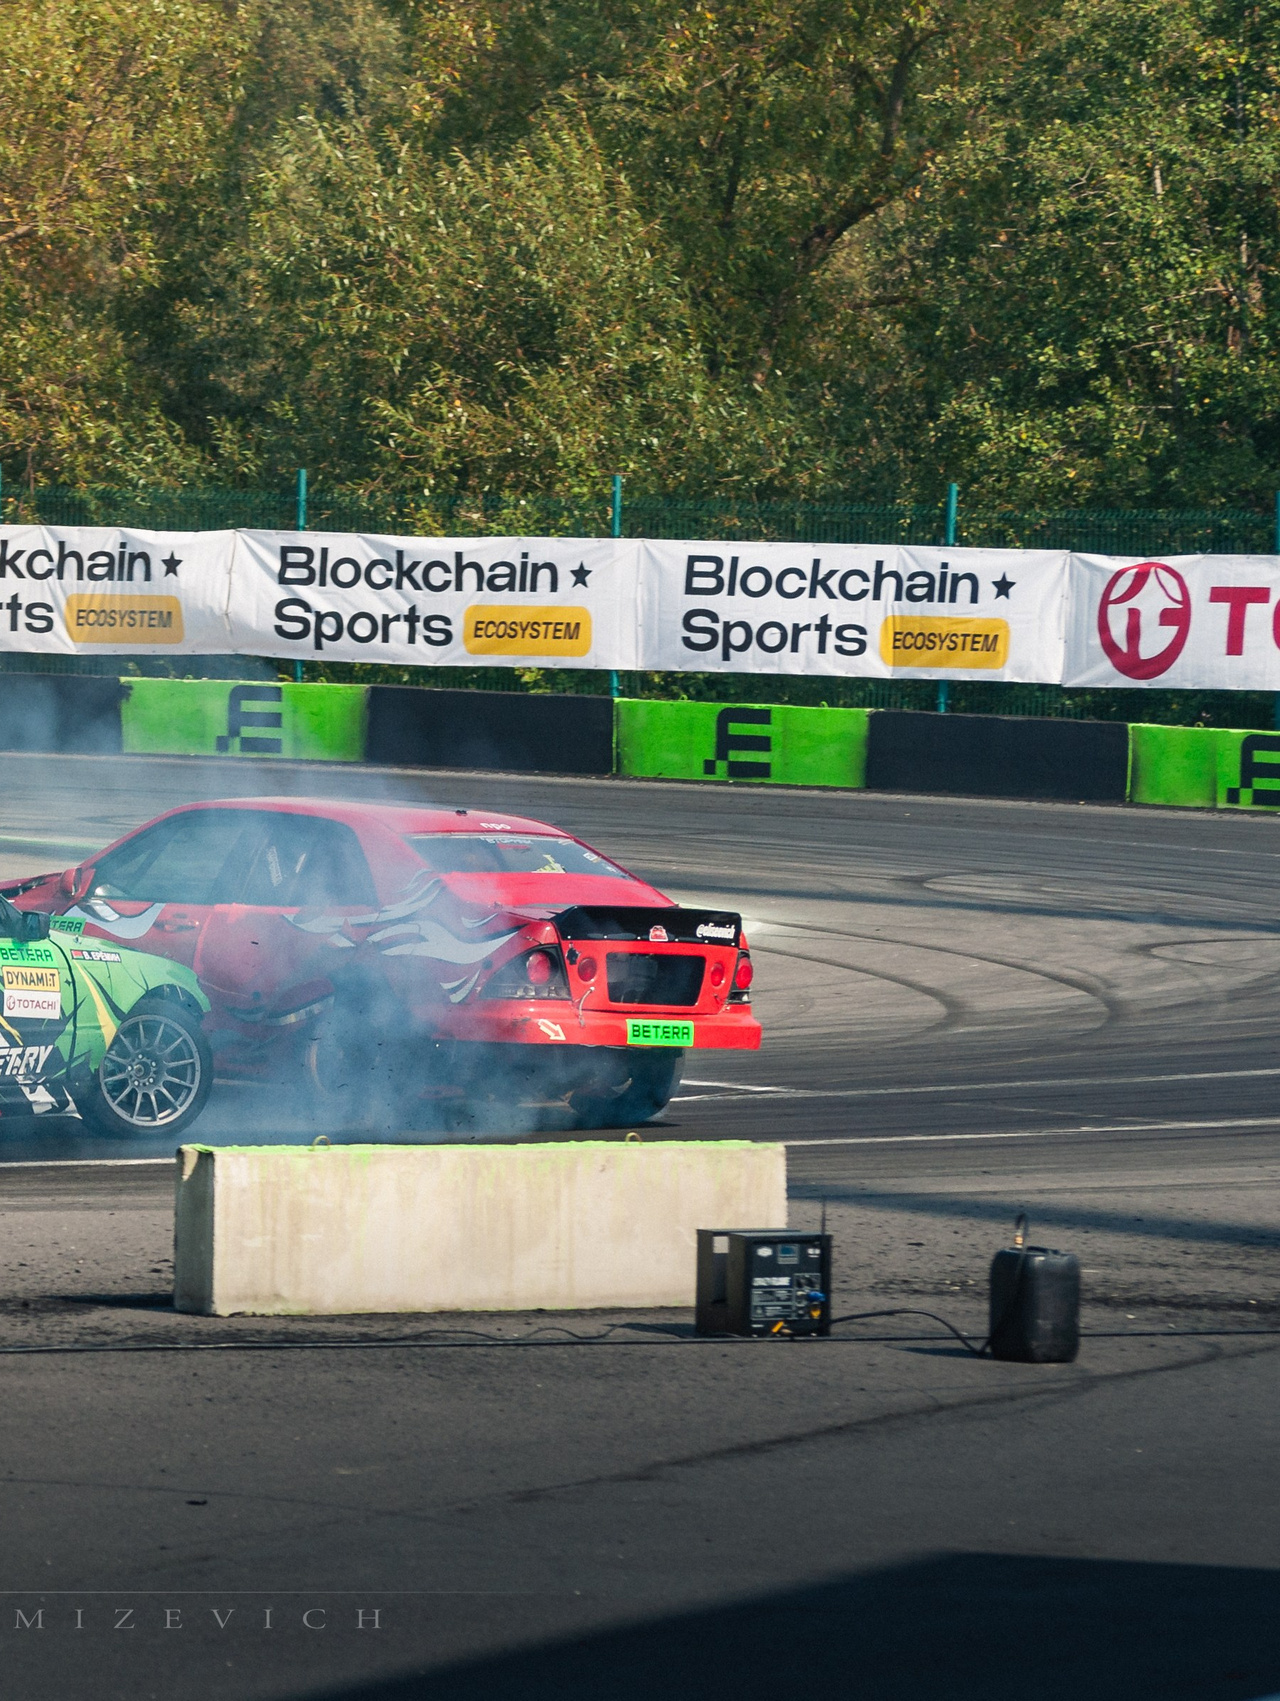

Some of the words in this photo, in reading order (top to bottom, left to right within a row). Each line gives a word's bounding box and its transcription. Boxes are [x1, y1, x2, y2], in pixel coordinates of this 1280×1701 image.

[279, 545, 558, 593] Blockchain
[684, 554, 980, 604] Blockchain
[75, 608, 173, 630] ECOSYSTEM
[274, 598, 453, 650] Sports
[474, 620, 581, 641] ECOSYSTEM
[682, 608, 868, 661] Sports
[892, 631, 1000, 653] ECOSYSTEM
[1209, 586, 1280, 656] T
[16, 998, 57, 1011] TOTACHI
